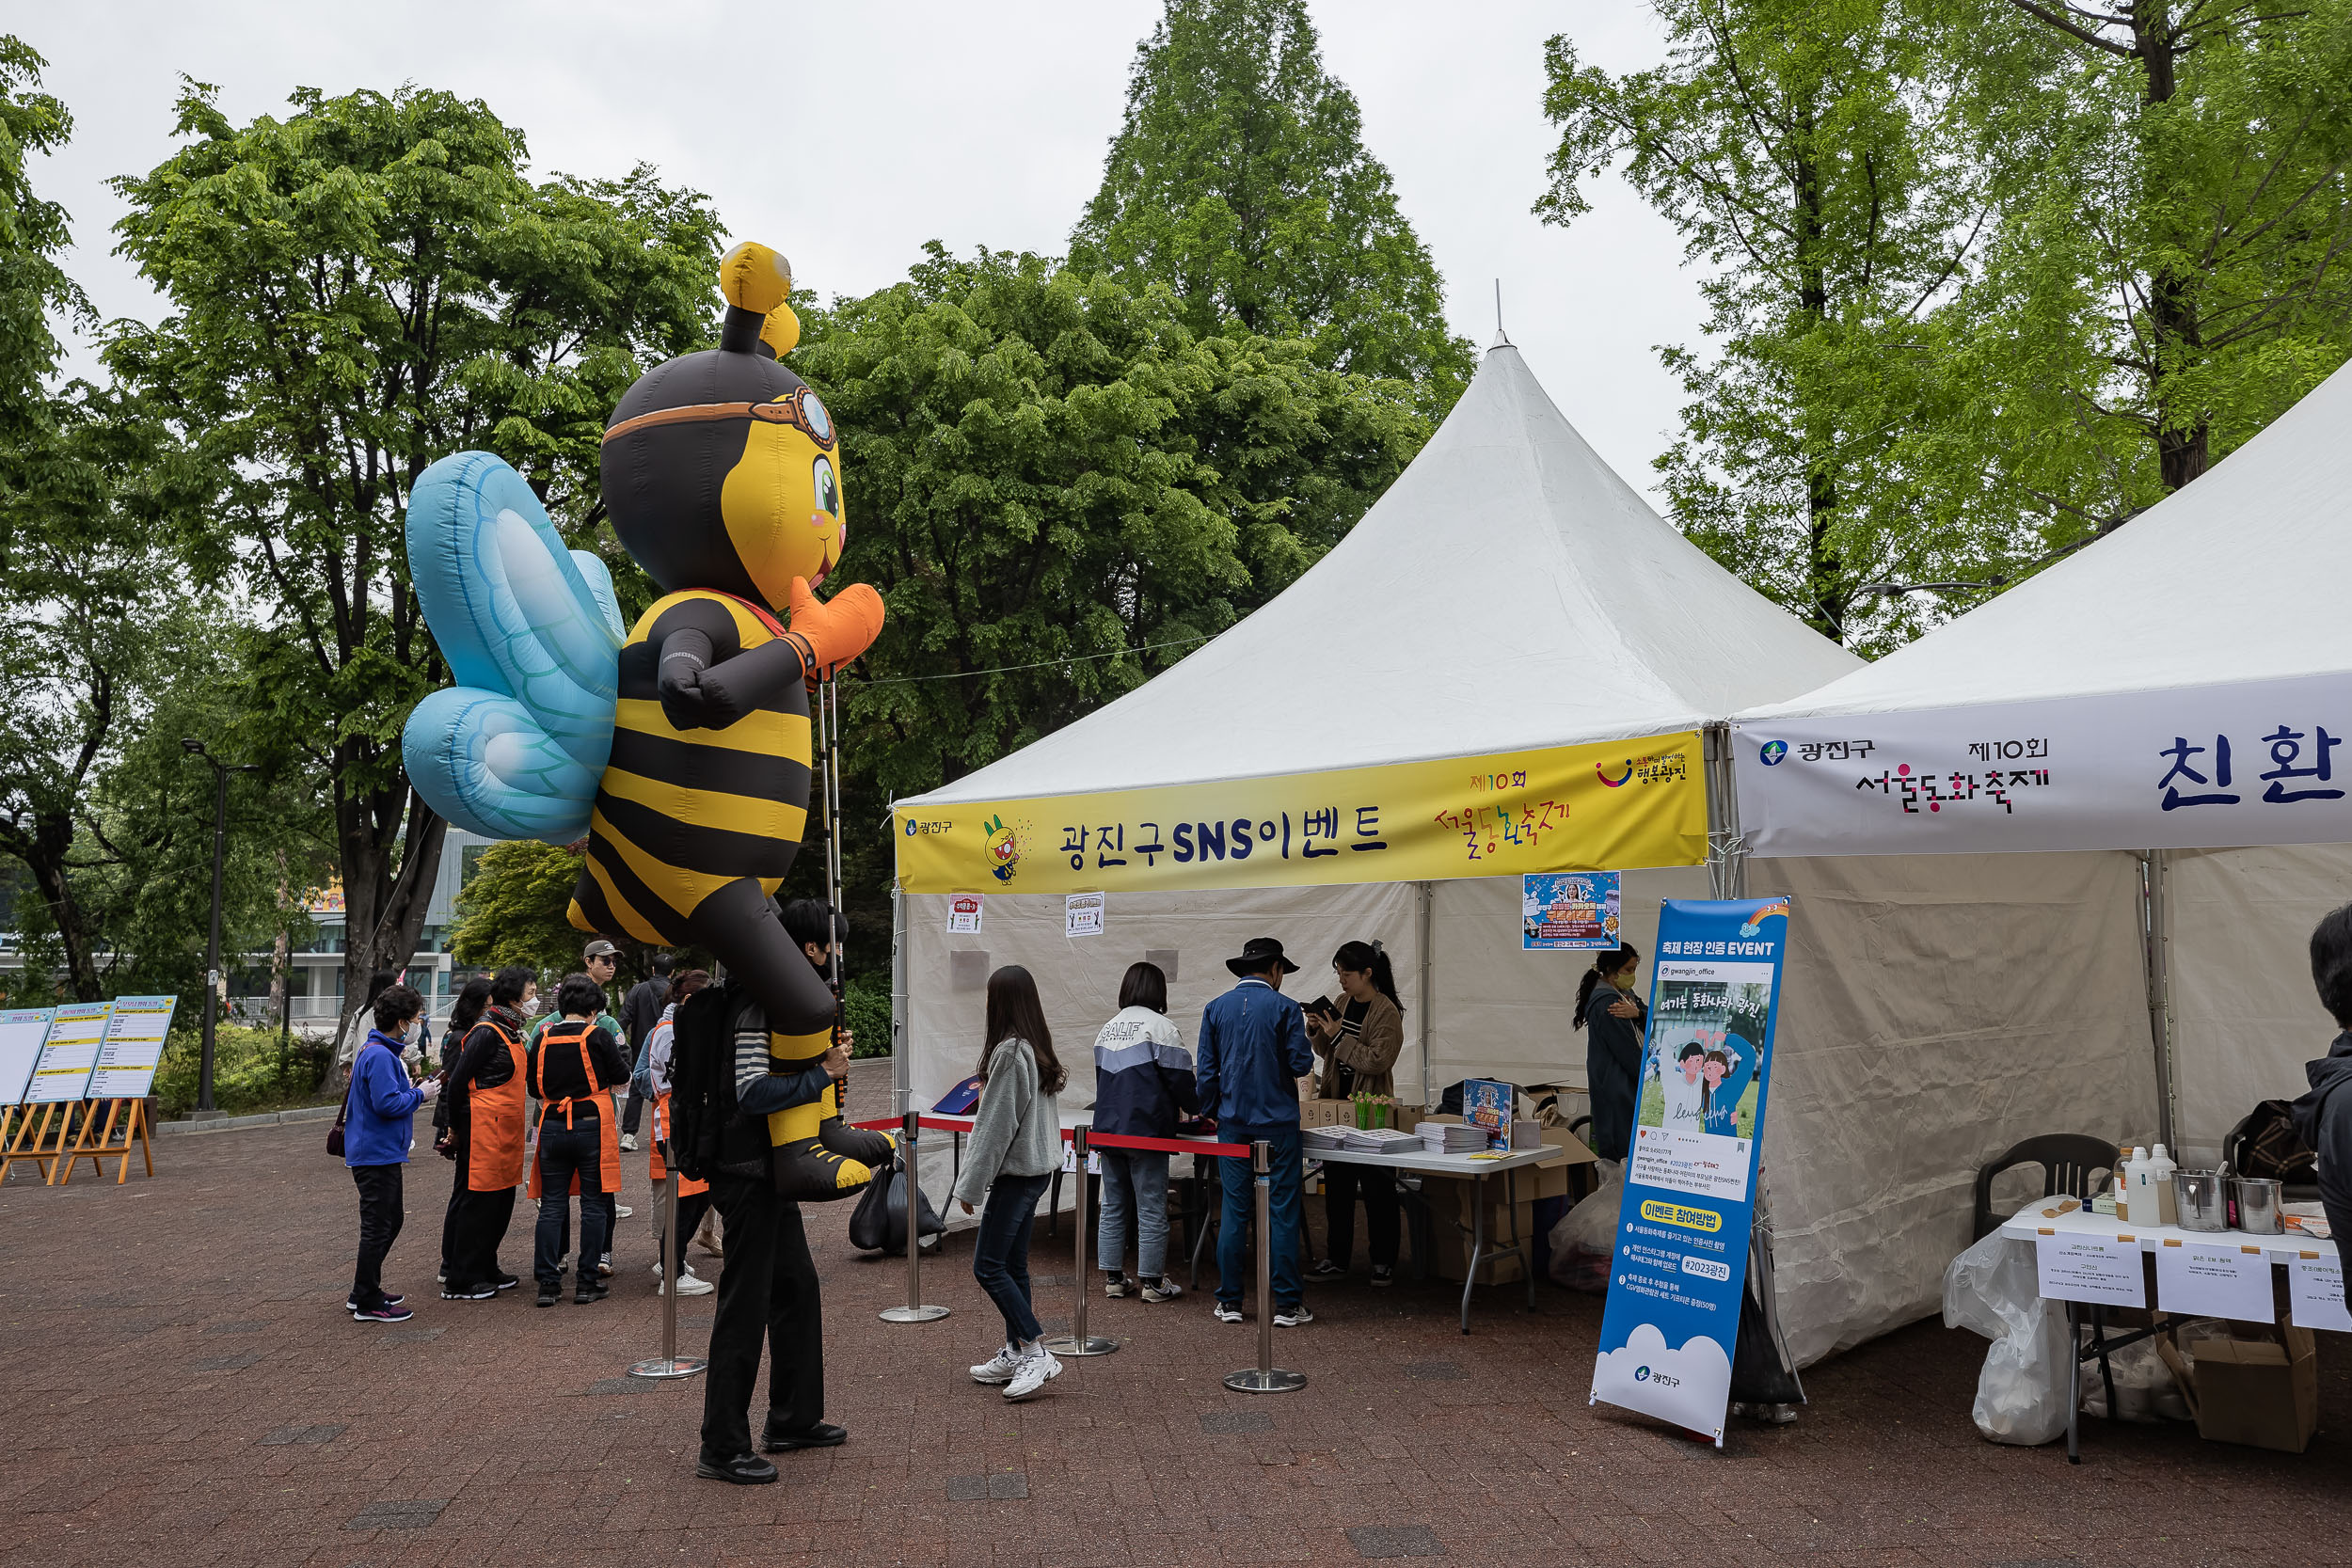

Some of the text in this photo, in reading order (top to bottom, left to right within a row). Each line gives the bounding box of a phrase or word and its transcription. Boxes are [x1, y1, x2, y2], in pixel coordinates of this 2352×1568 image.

[1796, 739, 1876, 761] 광진구
[1968, 737, 2049, 761] 제10회
[1470, 769, 1527, 792] 제10회
[1637, 764, 1686, 784] 행복광진
[1855, 763, 2050, 814] 서울동화축제
[919, 821, 952, 834] 광진구
[1434, 800, 1570, 860] 서울동화축제
[1662, 942, 1774, 956] 축제 현장 인증 EVENT
[1661, 992, 1760, 1018] 여기는 동화나라 광진
[1102, 1022, 1141, 1038] CALIF
[1670, 1160, 1693, 1169] #2023광진
[1645, 1203, 1717, 1228] 이벤트 참여방법
[1693, 1237, 1713, 1248] 인증사진
[1685, 1260, 1726, 1278] #2023광진
[1652, 1371, 1680, 1388] 광진구
